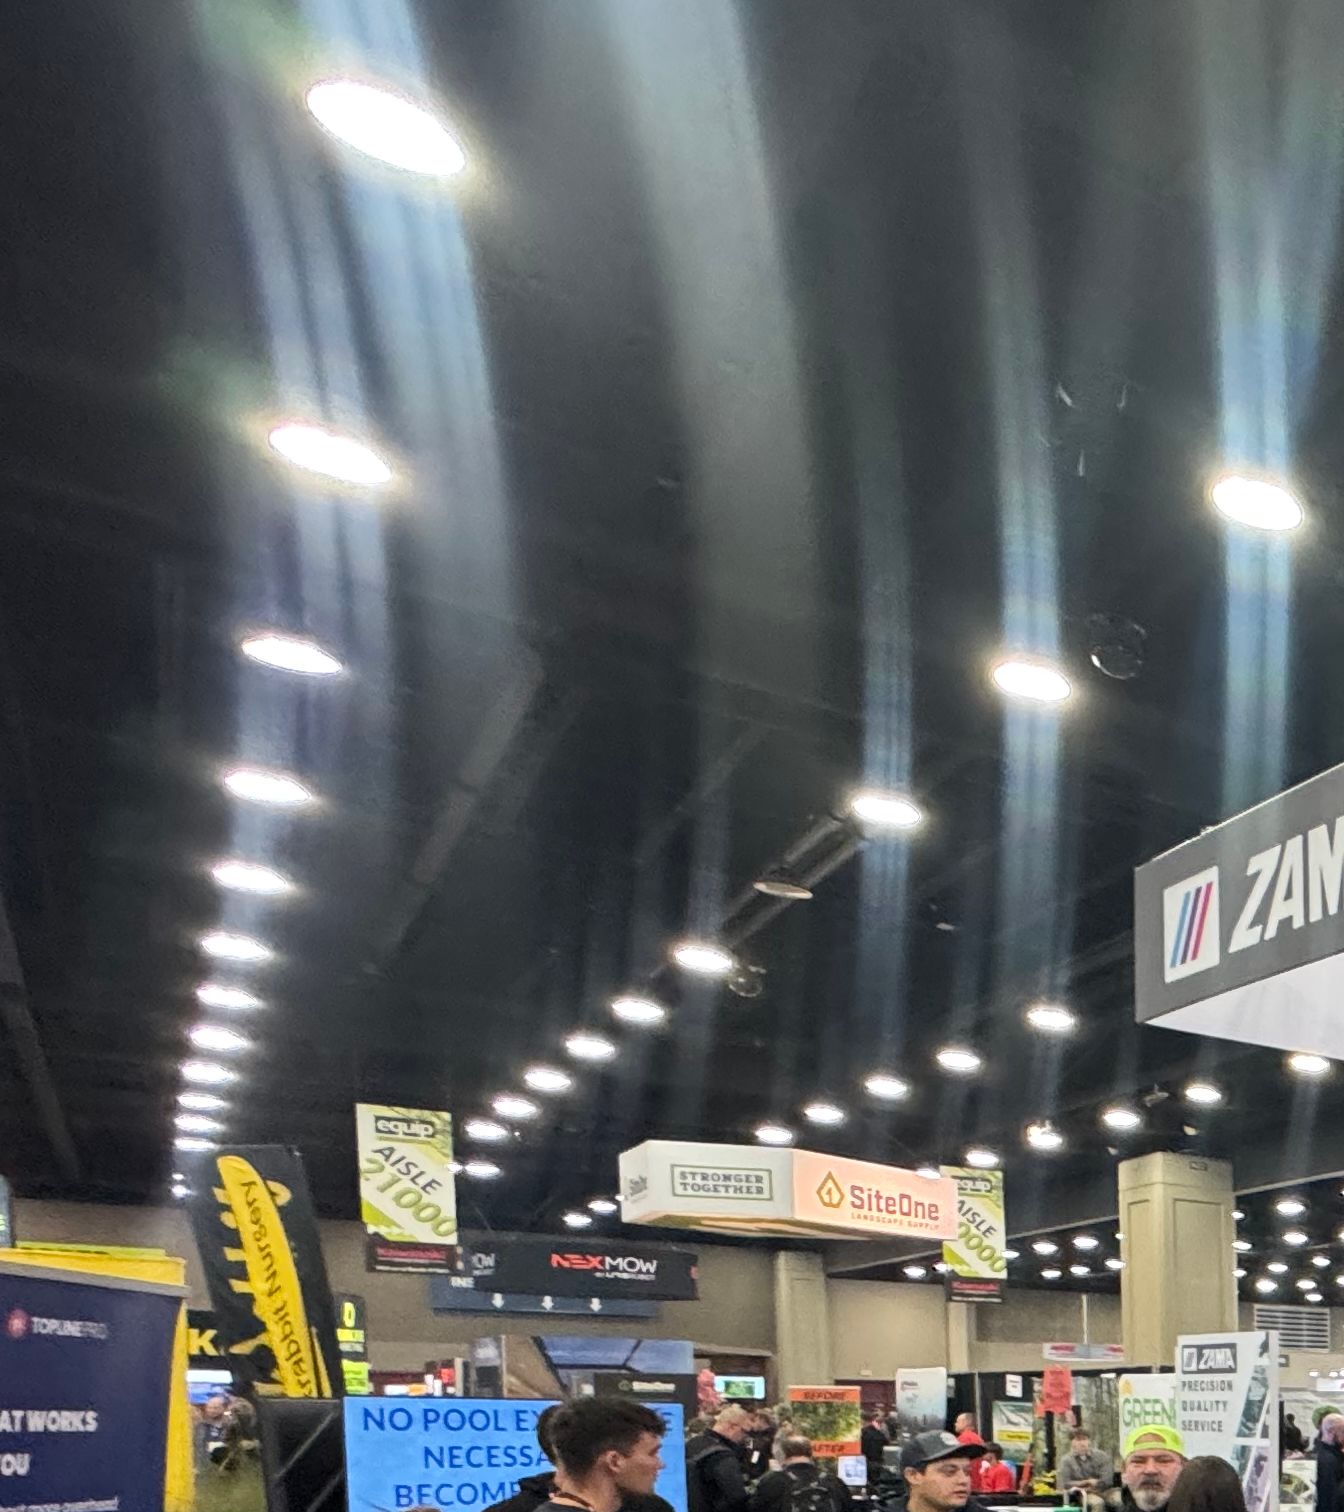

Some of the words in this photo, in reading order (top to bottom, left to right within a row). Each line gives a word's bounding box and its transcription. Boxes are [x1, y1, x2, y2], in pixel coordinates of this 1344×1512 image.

[376, 1119, 434, 1138] equip
[372, 1145, 443, 1195] AISLE
[679, 1171, 765, 1184] STRONGER
[360, 1158, 457, 1237] 21000
[679, 1182, 764, 1195] TOGETHER
[850, 1184, 940, 1221] SiteOne
[958, 1221, 1006, 1273] 0000
[273, 1301, 313, 1397] rabbit
[1198, 1348, 1236, 1370] ZAMA
[1182, 1379, 1234, 1392] PRECISION
[1181, 1400, 1228, 1412] QUALITY
[0, 1410, 25, 1432] AT
[26, 1410, 99, 1432] WORKS
[362, 1407, 413, 1431] NO
[423, 1408, 506, 1431] POOL
[1181, 1420, 1224, 1432] SERVICE
[0, 1453, 32, 1477] OU
[424, 1445, 552, 1469] NECESSA
